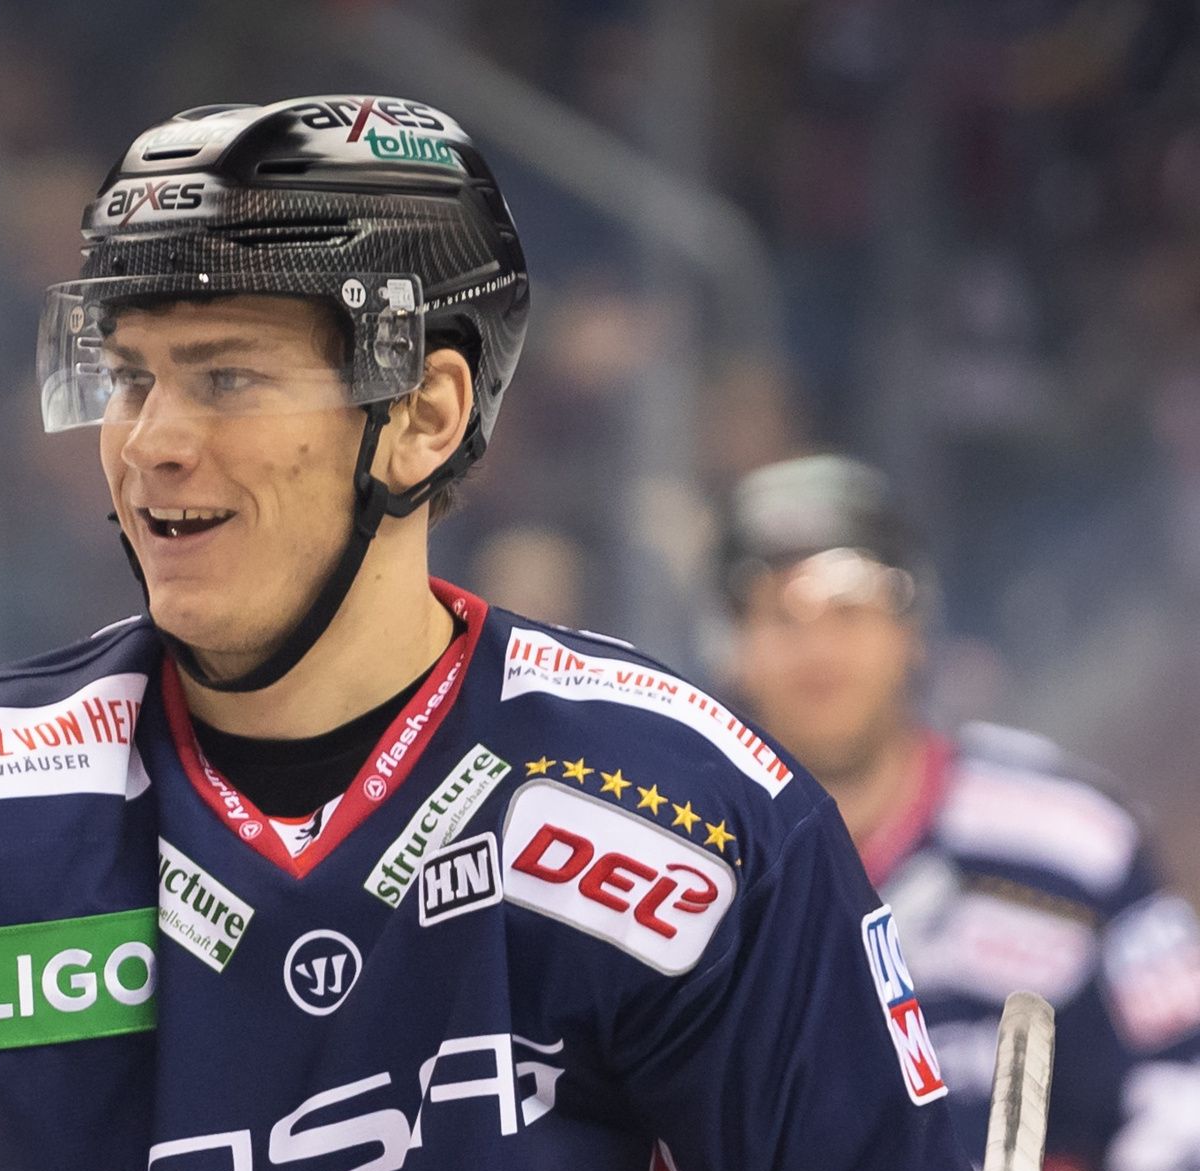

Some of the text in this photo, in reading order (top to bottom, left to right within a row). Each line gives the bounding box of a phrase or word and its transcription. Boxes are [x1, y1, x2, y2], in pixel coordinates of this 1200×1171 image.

[12, 710, 84, 750] VON
[82, 696, 140, 745] HEI
[377, 752, 495, 904] structure
[424, 846, 490, 910] HN
[511, 823, 719, 940] DEL
